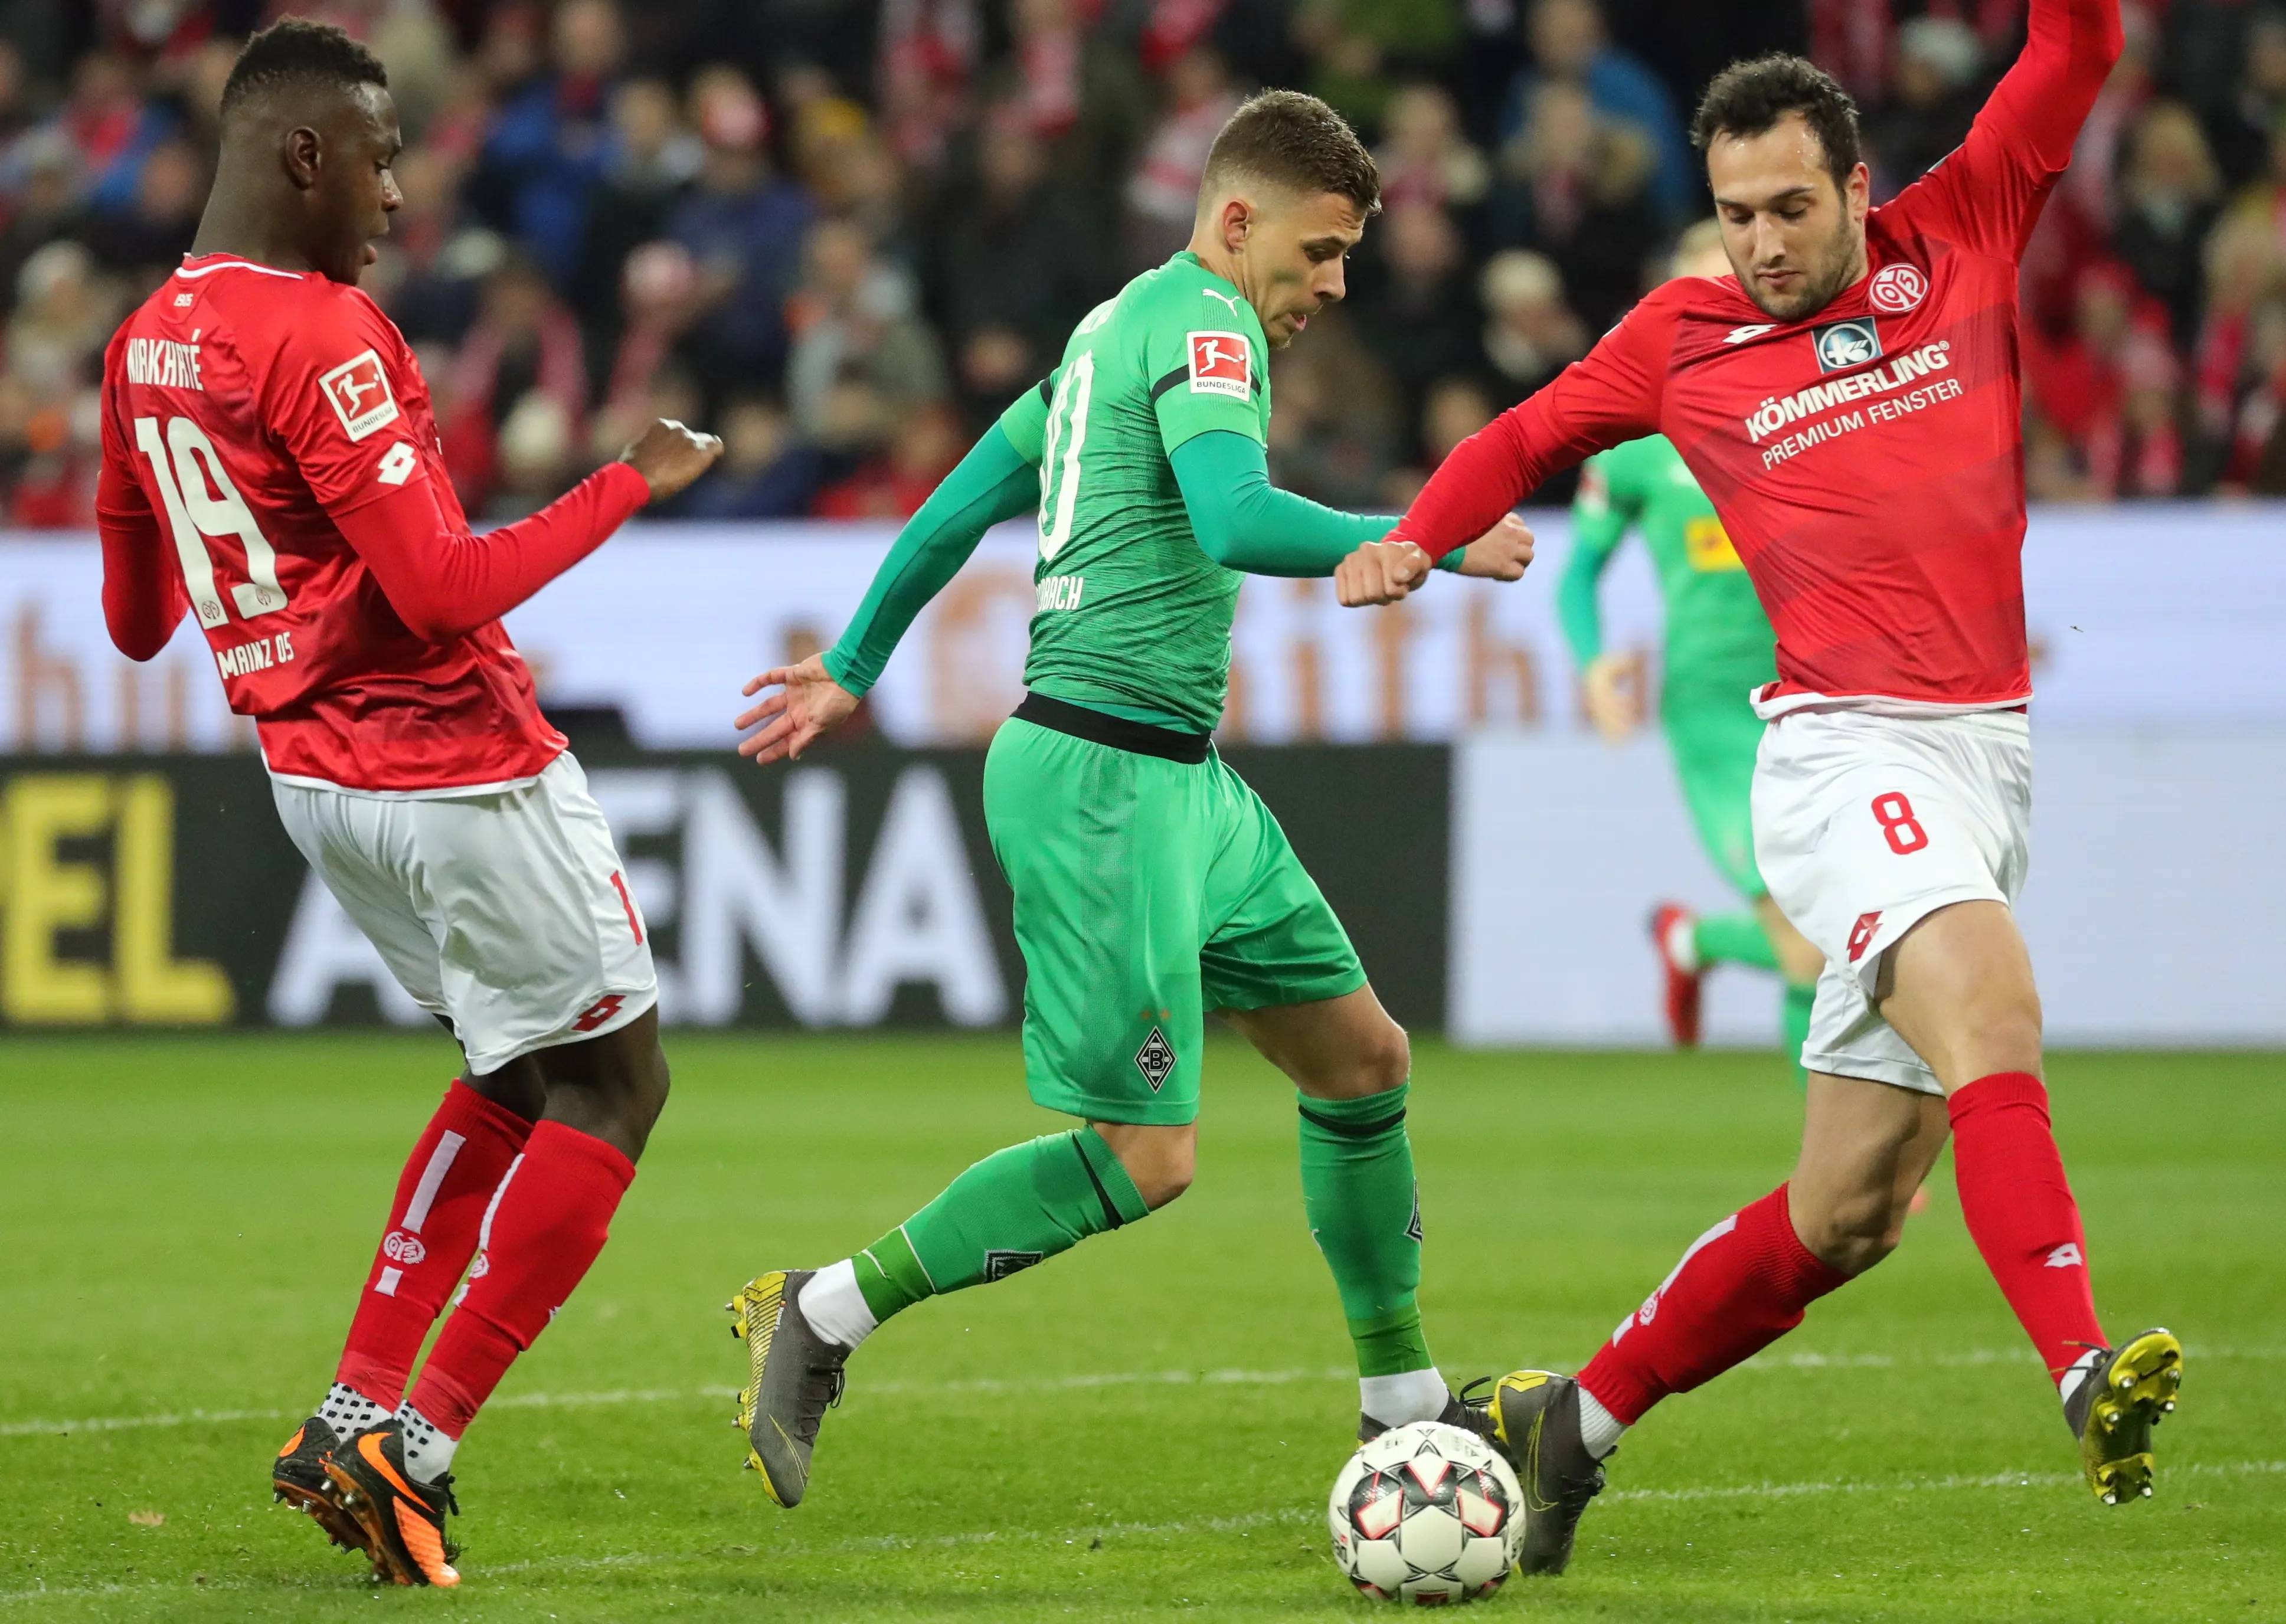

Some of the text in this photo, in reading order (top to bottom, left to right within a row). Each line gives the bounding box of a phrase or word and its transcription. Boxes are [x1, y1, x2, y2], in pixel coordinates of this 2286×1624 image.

[352, 406, 393, 434] BUNDESLIGA
[1196, 381, 1246, 394] BUNDESLIGA
[1745, 343, 1950, 443] KÖMMERLING
[1761, 378, 1963, 470] PREMIUM FENSTER
[134, 416, 289, 629] 19
[216, 630, 295, 679] MAINZ 05
[1871, 791, 1928, 855] 8
[264, 764, 1010, 1027] AENA
